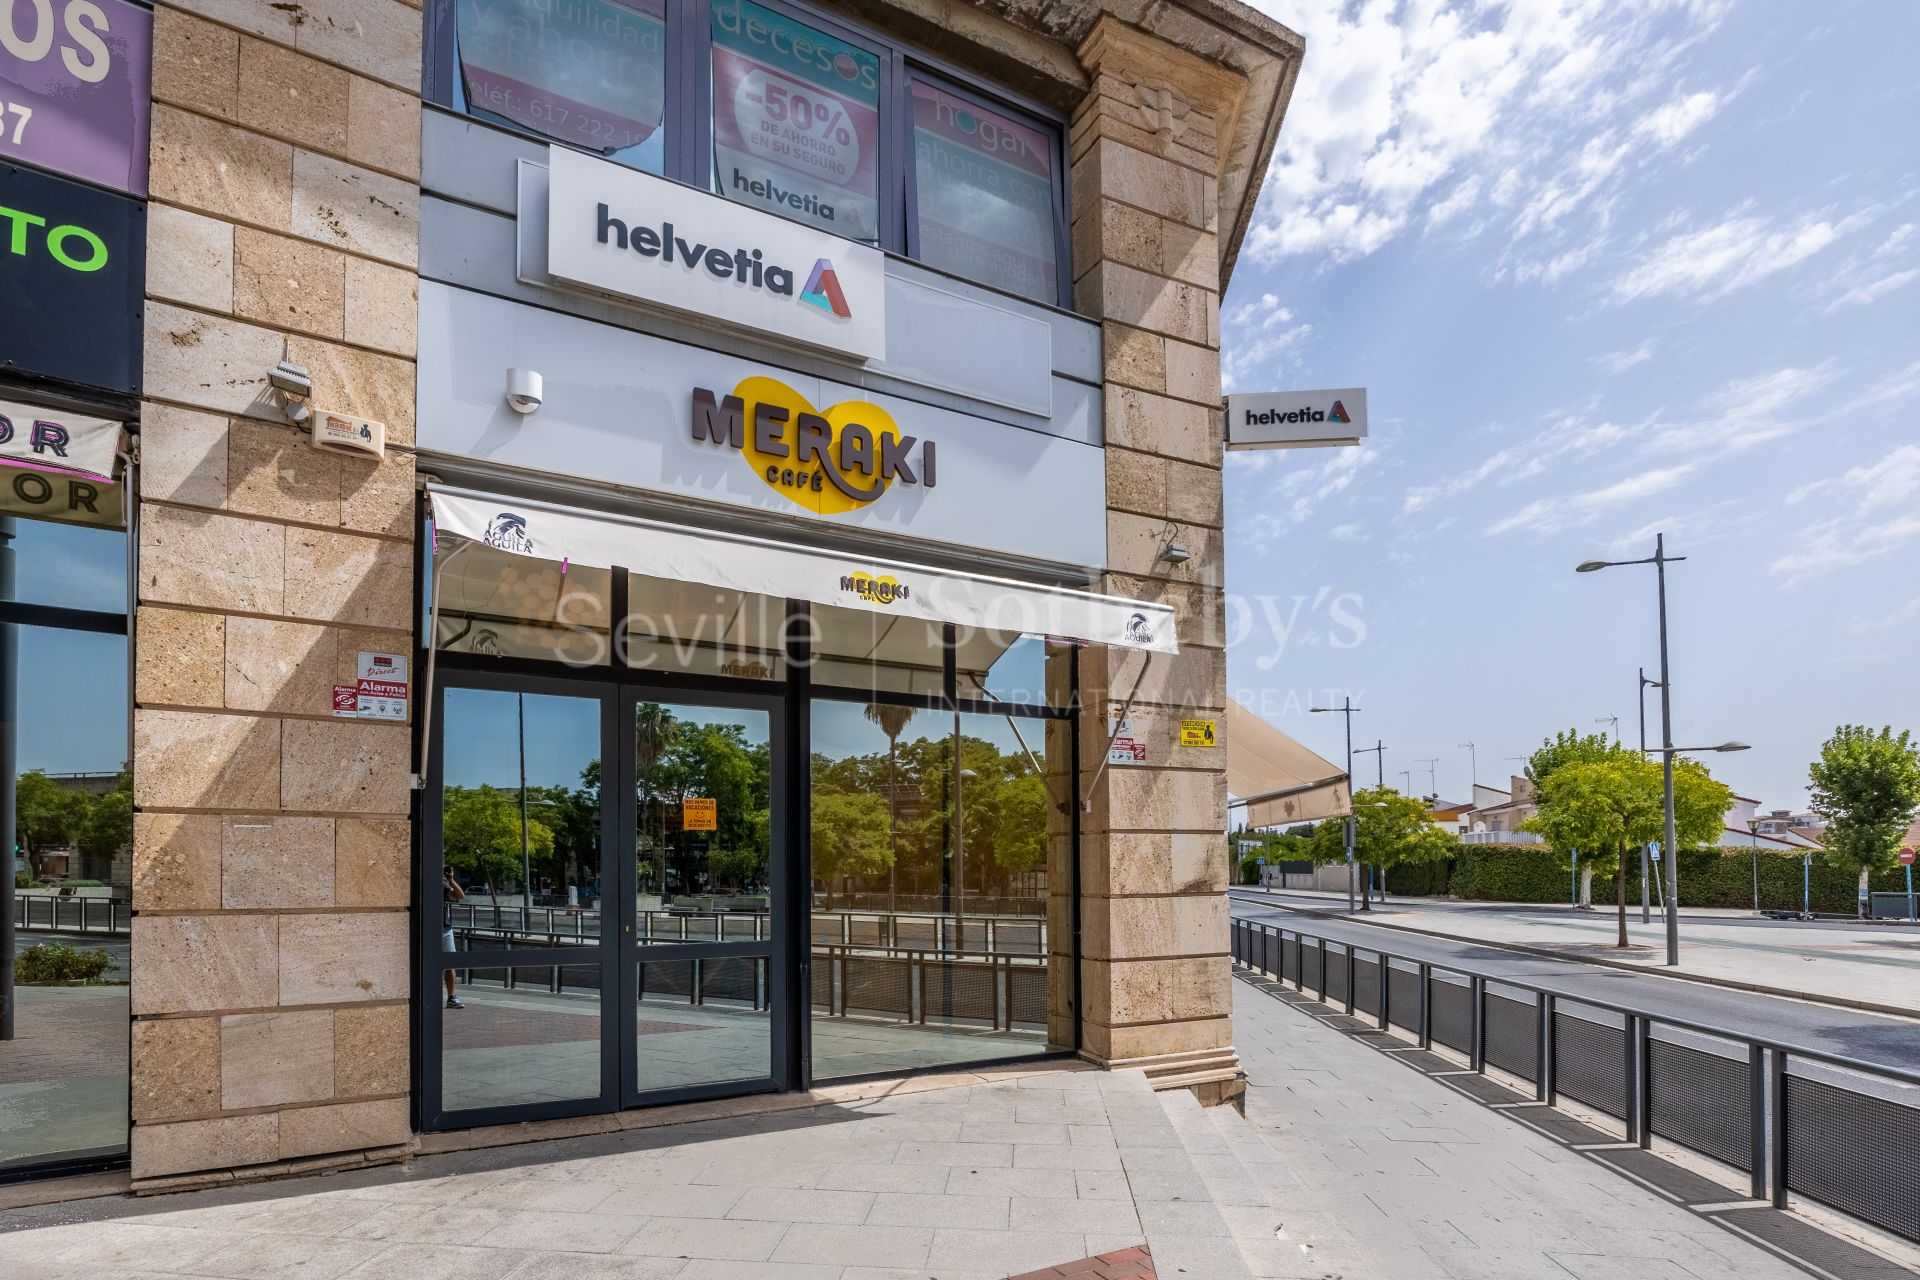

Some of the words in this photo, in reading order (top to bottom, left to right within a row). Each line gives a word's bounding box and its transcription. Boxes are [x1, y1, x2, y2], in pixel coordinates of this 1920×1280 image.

[716, 0, 877, 91] decesos
[529, 99, 569, 126] 617
[576, 114, 615, 142] 222
[744, 82, 850, 147] -50%
[760, 119, 779, 137] DE
[782, 129, 836, 157] AHORRO
[936, 90, 1031, 155] hogar
[750, 132, 770, 149] EN
[771, 139, 790, 156] SU
[793, 149, 846, 176] SEGURO
[917, 142, 999, 186] ahorra
[1008, 177, 1050, 205] con
[732, 166, 835, 221] helvetia
[596, 201, 794, 297] helvetia
[919, 225, 988, 255] estamos
[1245, 405, 1325, 426] helvetia
[691, 386, 937, 502] MERAKI
[839, 575, 911, 605] MERAKI
[359, 681, 406, 694] Alarma
